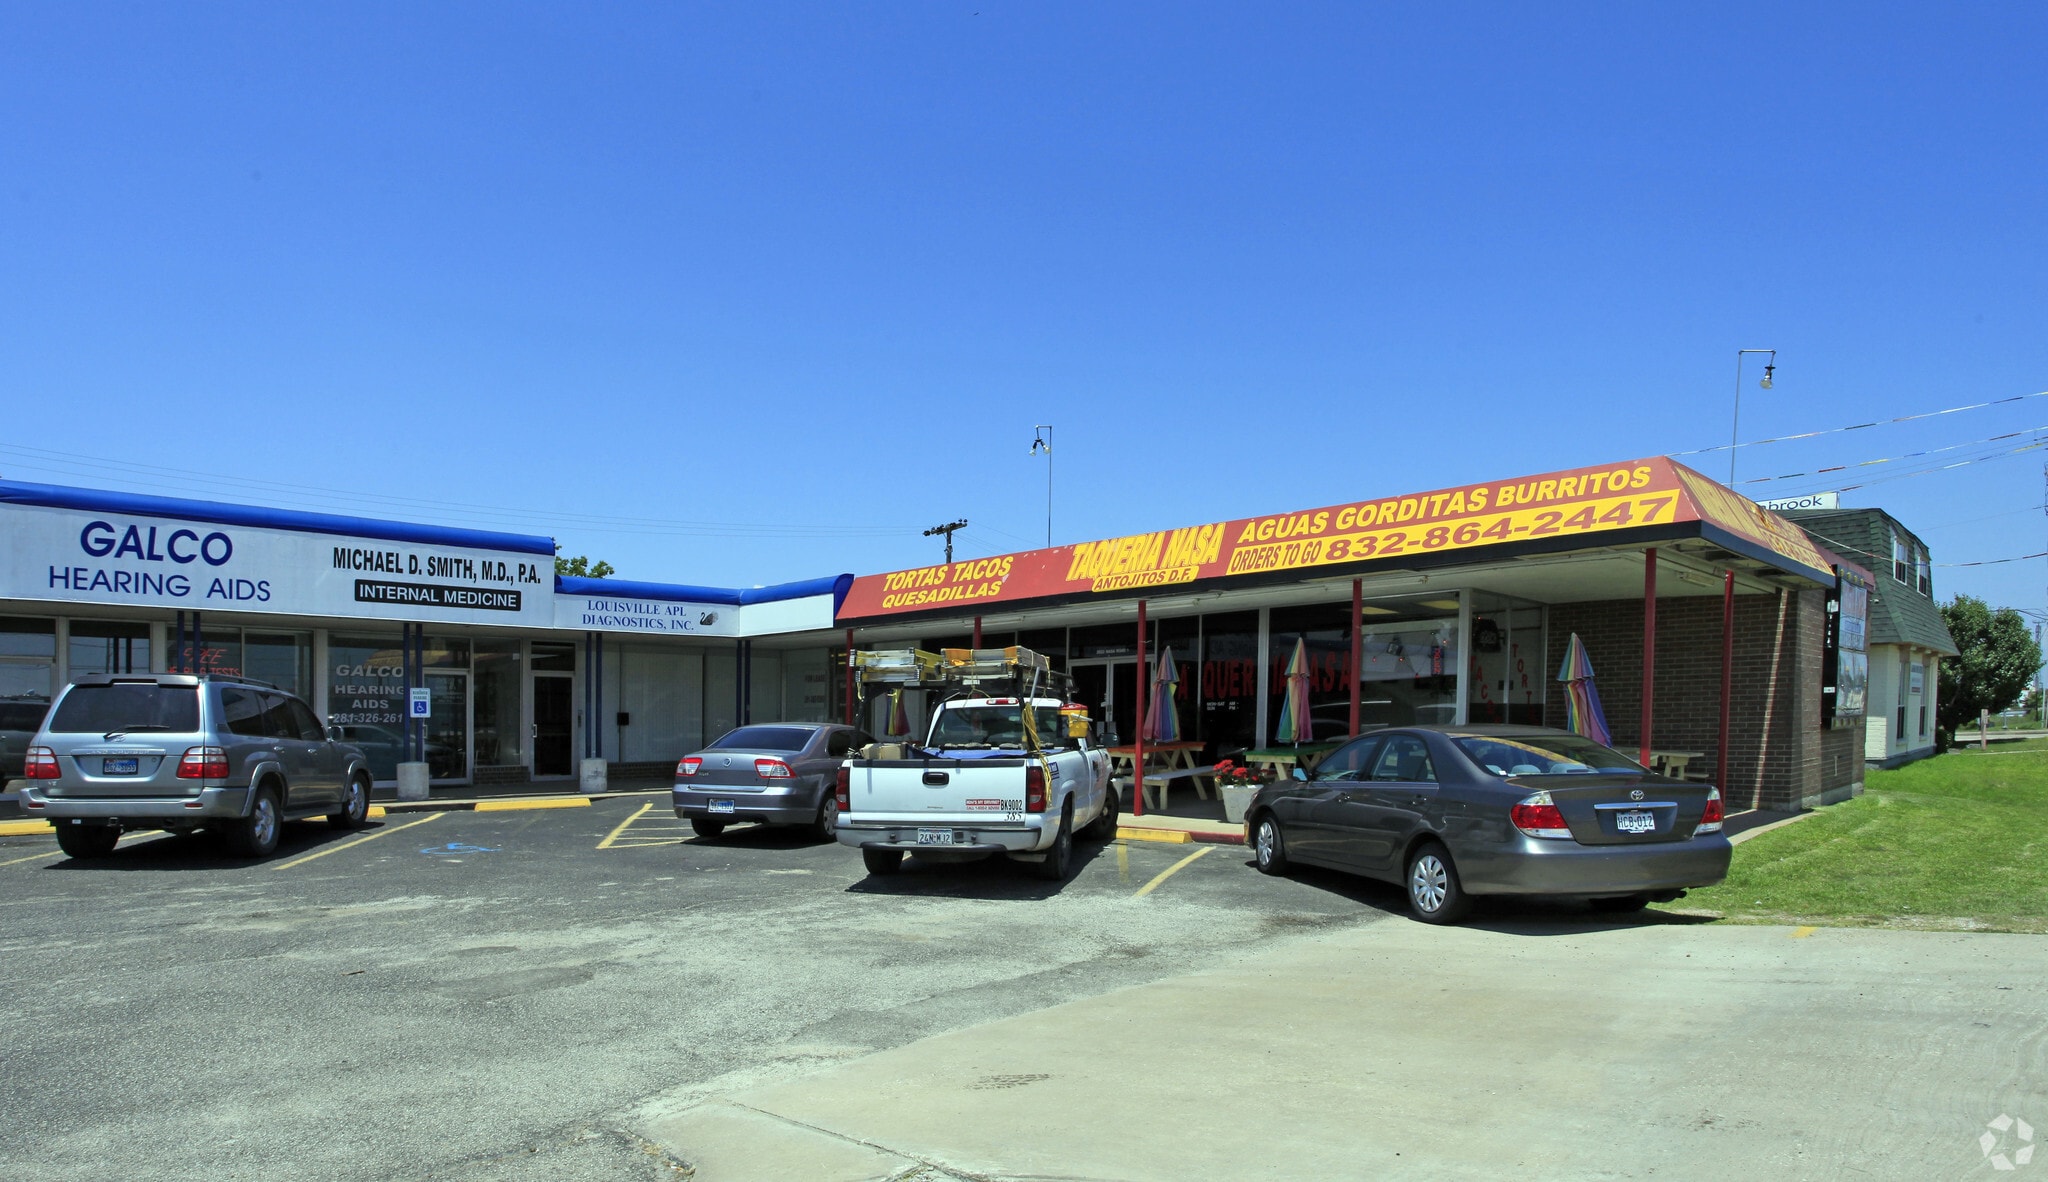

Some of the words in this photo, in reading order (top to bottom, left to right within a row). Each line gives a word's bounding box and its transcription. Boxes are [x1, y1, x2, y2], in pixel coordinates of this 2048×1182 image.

[1237, 511, 1330, 544] AGUAS
[1335, 487, 1488, 530] GORDITAS
[1495, 466, 1652, 507] BURRITOS
[80, 520, 234, 566] GALCO
[1231, 545, 1282, 573] ORDERS
[1282, 543, 1300, 567] TO
[1301, 540, 1323, 564] GO
[1325, 496, 1673, 561] 832-864-2447
[1065, 530, 1166, 581] TAQUERIA
[1160, 522, 1227, 569] NASA
[333, 547, 403, 573] MICHAEL
[408, 554, 422, 575] D.
[427, 555, 477, 583] SMITH,
[482, 560, 513, 586] M.D.,
[518, 563, 541, 584] P.A.
[883, 565, 949, 592] TORTAS
[952, 556, 1014, 582] TACOS
[49, 565, 191, 597] HEARING
[206, 577, 271, 601] AIDS
[1094, 571, 1166, 590] ANTOJITOS
[1168, 568, 1191, 582] D.F.
[359, 584, 439, 602] INTERNAL
[444, 590, 517, 607] MEDICINE
[882, 580, 1003, 608] QUESADILLAS
[588, 600, 660, 615] LOUISVILLE
[664, 606, 687, 616] APL
[582, 614, 667, 630] DIAGNOSTICS,
[671, 620, 694, 631] INC.
[335, 664, 404, 678] GALCO
[335, 685, 404, 695] HEARING
[352, 699, 389, 709] AIDS
[333, 713, 404, 723] 281-326-261
[1000, 799, 1023, 811] BK9002
